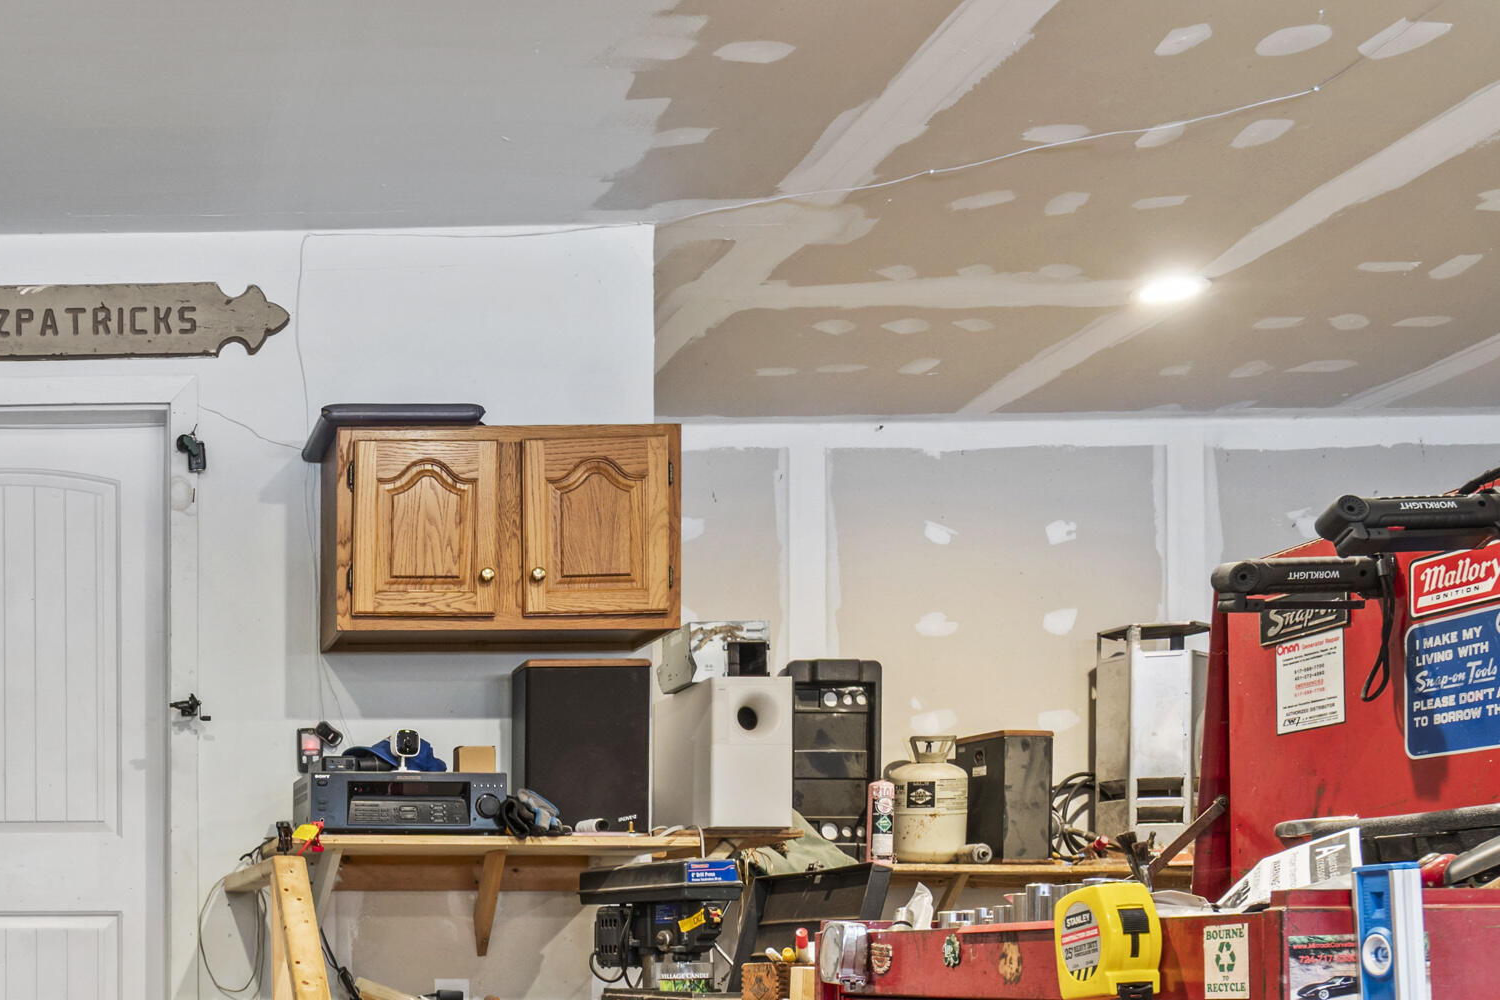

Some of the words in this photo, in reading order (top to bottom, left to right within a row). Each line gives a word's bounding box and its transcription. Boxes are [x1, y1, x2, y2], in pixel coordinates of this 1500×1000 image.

[1400, 500, 1458, 510] WORKLIGHT
[1287, 570, 1340, 580] WORKLIGHT
[1420, 557, 1500, 594] Mallory
[1431, 584, 1480, 601] IGNITION
[1276, 642, 1300, 657] Onan
[1301, 640, 1325, 651] Generator
[1324, 636, 1341, 645] Repair
[1415, 639, 1420, 651] I
[1422, 631, 1459, 649] MAKE
[1462, 625, 1483, 641] MY
[1415, 648, 1453, 667] LIVING
[1457, 641, 1489, 659] WITH
[1414, 669, 1466, 694] Snap-on
[1466, 657, 1498, 685] Tools
[1413, 694, 1456, 713] PLEASE
[1458, 687, 1495, 704] DON'T
[1413, 715, 1429, 728] TO
[1433, 706, 1483, 726] BORROW
[1485, 702, 1500, 717] TH
[1066, 913, 1091, 928] STANLEY
[1205, 928, 1245, 941] BOURNE
[1074, 943, 1087, 952] HEAVY
[1086, 940, 1098, 949] DUTY
[686, 971, 709, 979] CANDLE
[1206, 982, 1246, 993] RECYCLE
